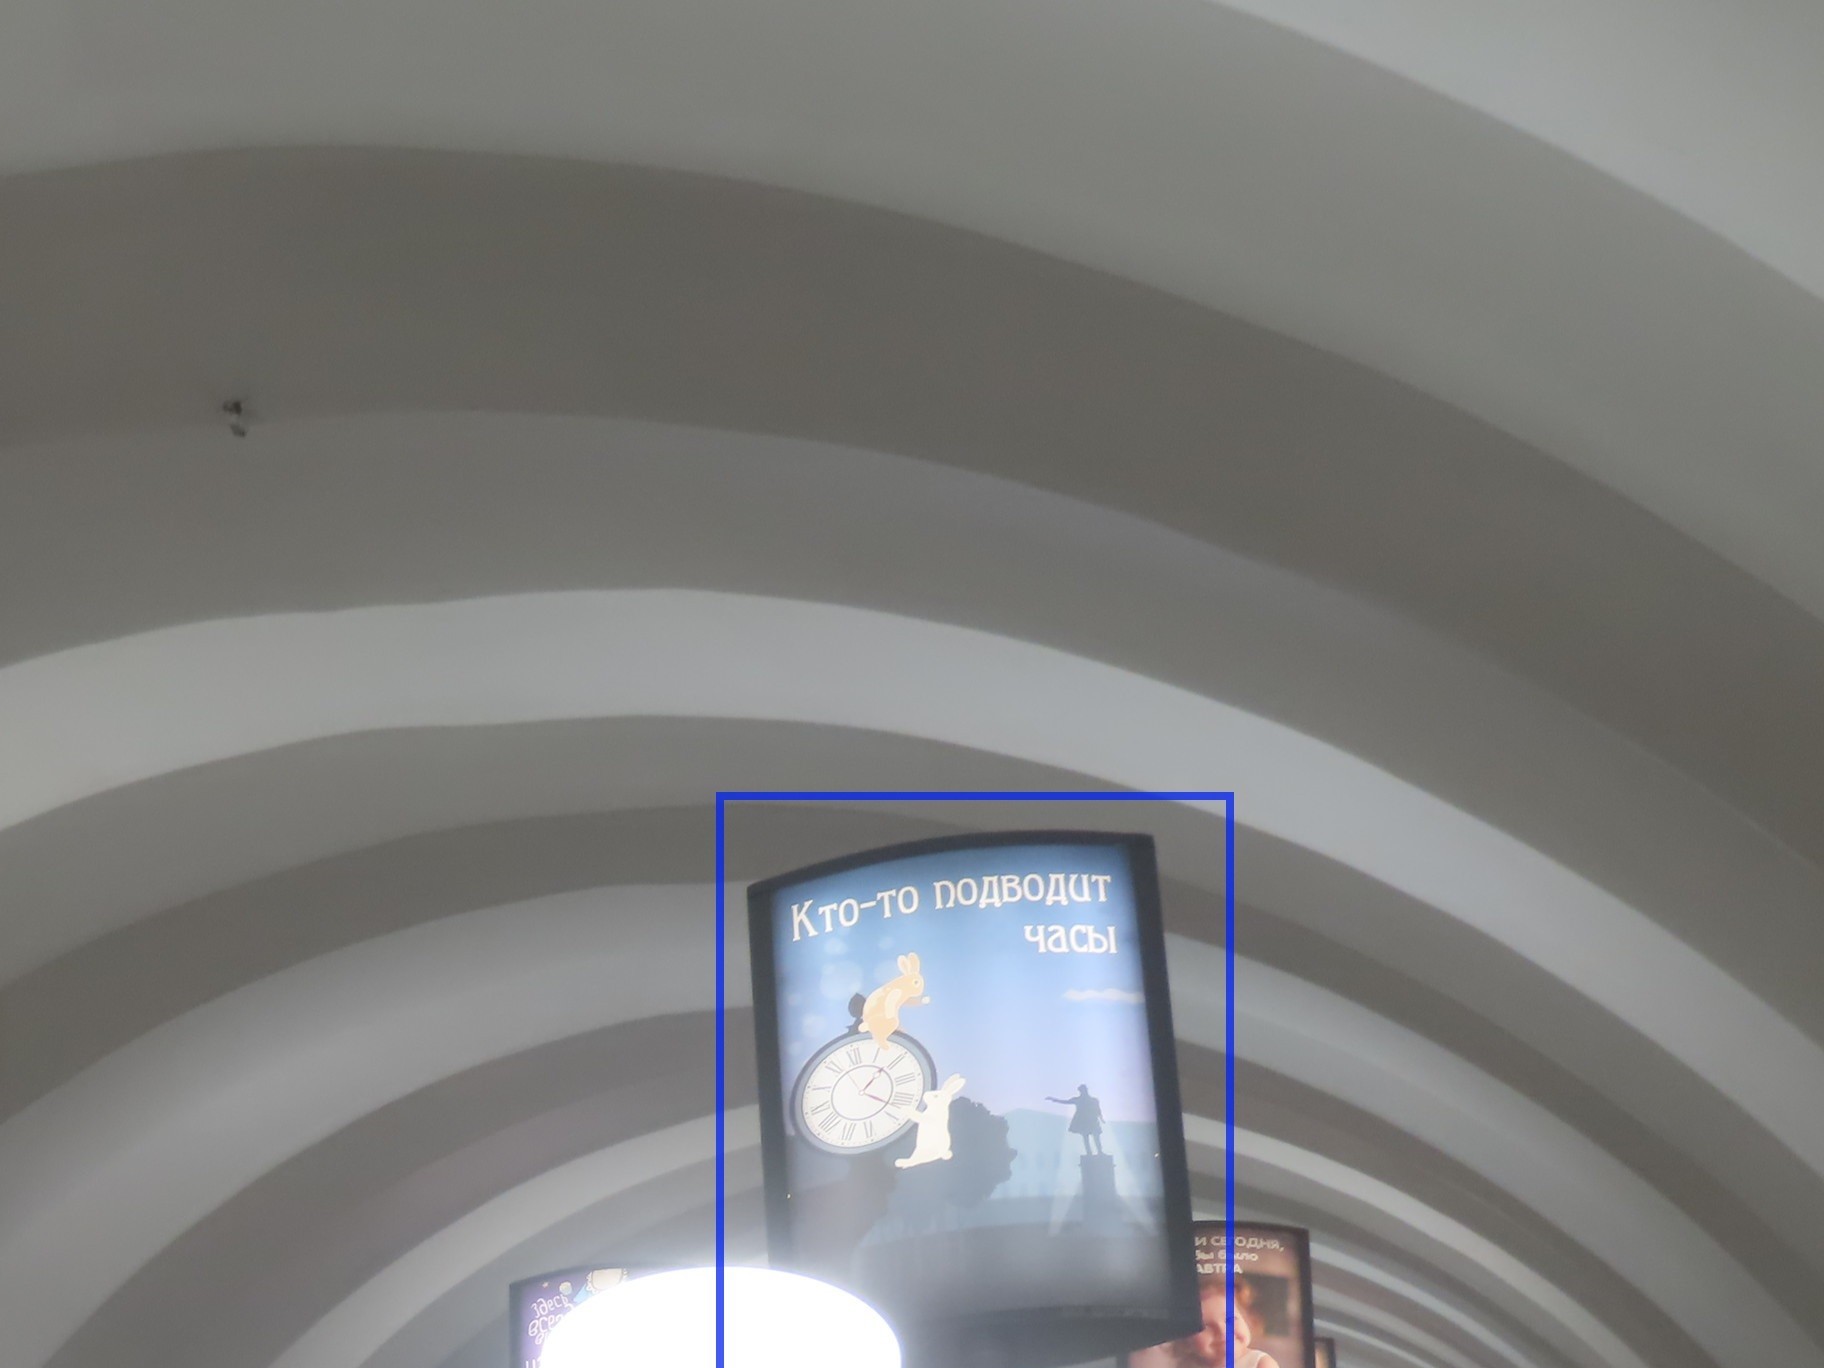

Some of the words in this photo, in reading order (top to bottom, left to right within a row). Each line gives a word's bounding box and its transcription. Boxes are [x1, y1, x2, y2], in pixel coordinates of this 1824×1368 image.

[791, 885, 920, 942] Кто-то
[933, 872, 1111, 910] подводит
[1024, 924, 1117, 954] часы
[1210, 1236, 1285, 1252] СЕОДНЯ,
[1218, 1249, 1259, 1261] бло
